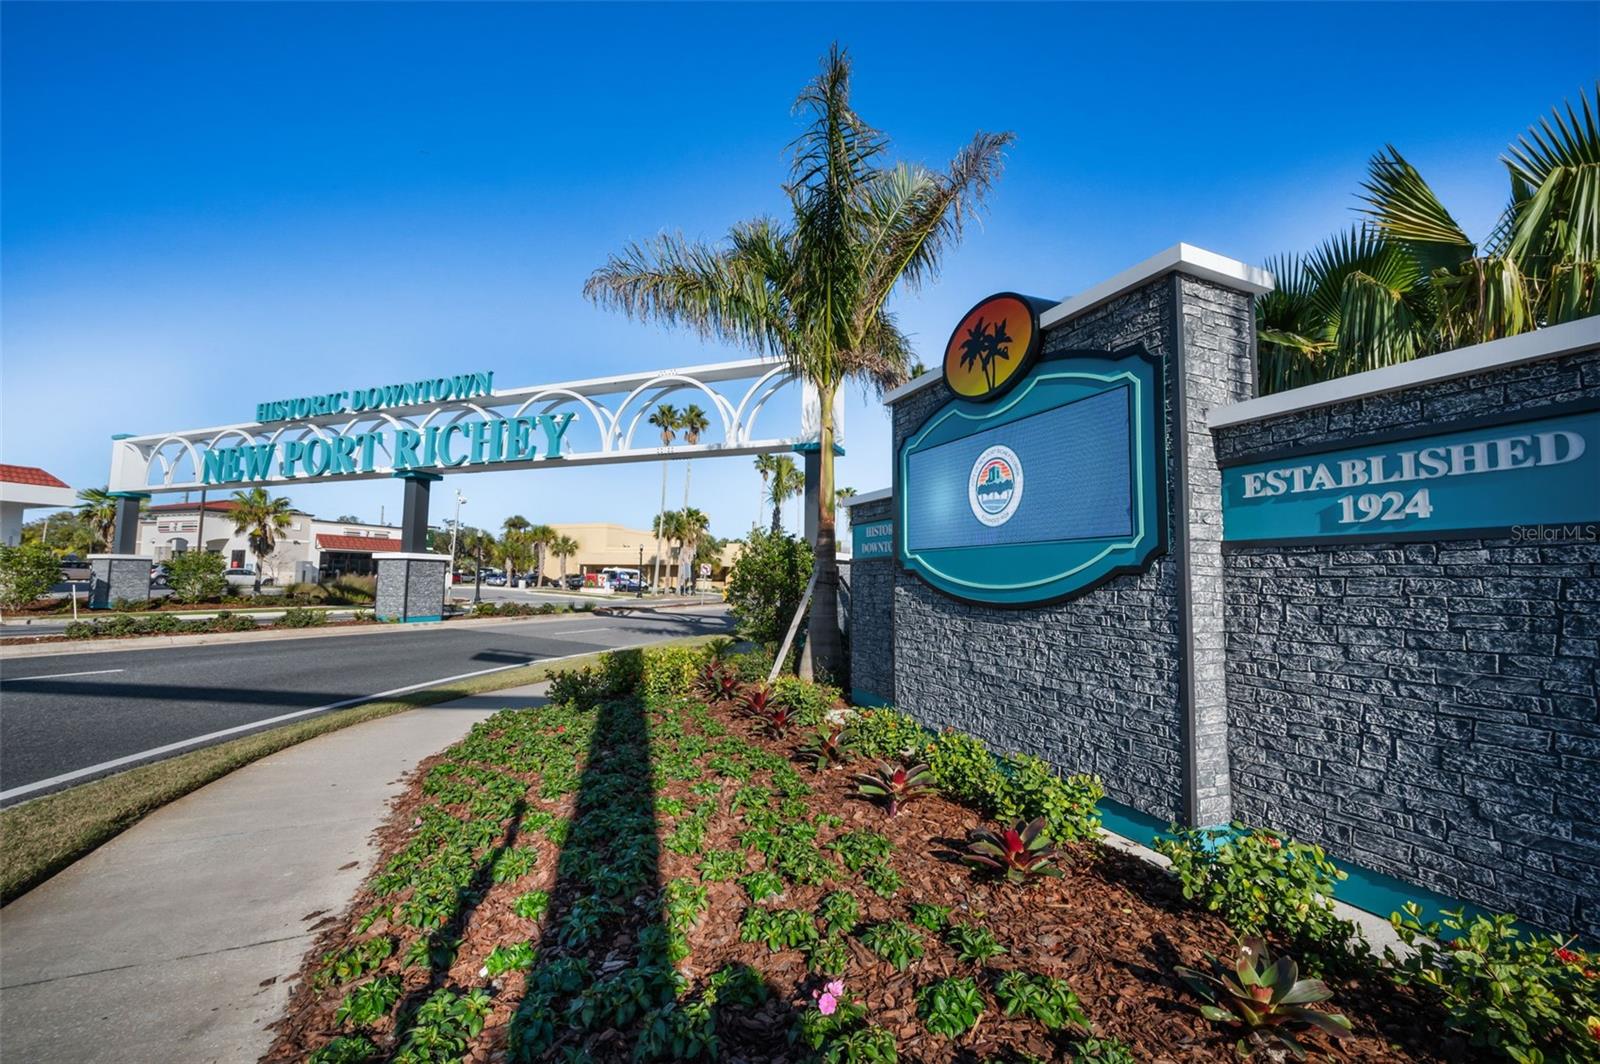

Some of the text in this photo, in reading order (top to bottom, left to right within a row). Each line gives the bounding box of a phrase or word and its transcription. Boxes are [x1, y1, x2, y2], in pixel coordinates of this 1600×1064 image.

[256, 371, 494, 423] HISTORIC DOWNTOWN
[200, 411, 575, 485] NEW PORT RICHEY
[1241, 430, 1586, 499] ESTABLISHED
[1337, 488, 1433, 524] 1924
